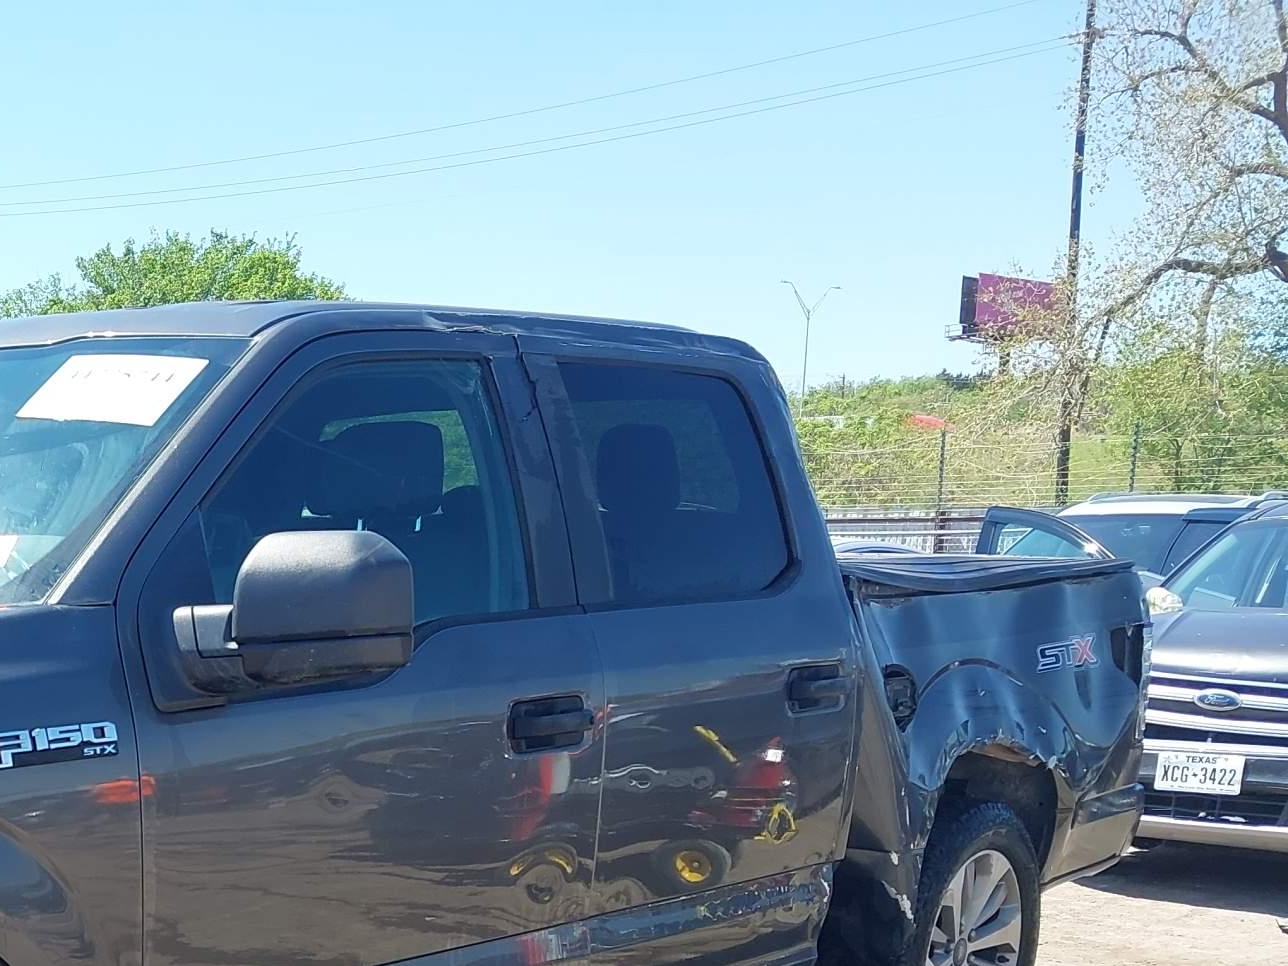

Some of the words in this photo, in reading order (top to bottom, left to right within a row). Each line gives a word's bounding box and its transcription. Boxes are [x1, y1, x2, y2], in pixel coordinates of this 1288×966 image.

[1037, 635, 1097, 672] STX
[83, 743, 118, 757] STX
[1185, 755, 1219, 765] TEXAS
